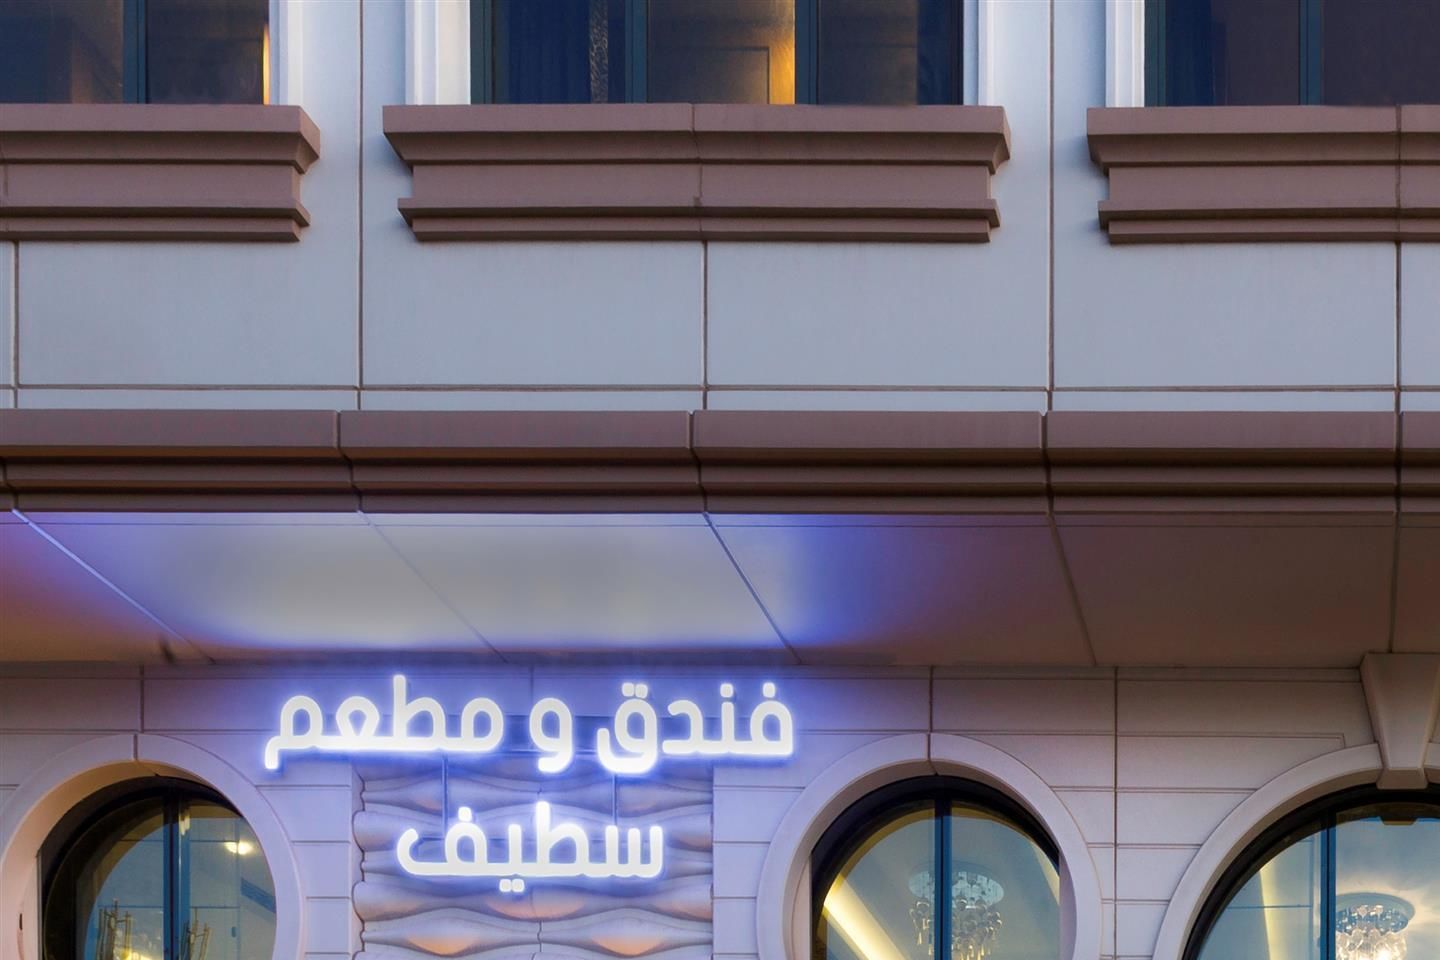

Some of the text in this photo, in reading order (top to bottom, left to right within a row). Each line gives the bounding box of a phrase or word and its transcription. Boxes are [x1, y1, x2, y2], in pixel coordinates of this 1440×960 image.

[264, 674, 794, 774] فندق و مطعم
[396, 801, 664, 893] سطيف
